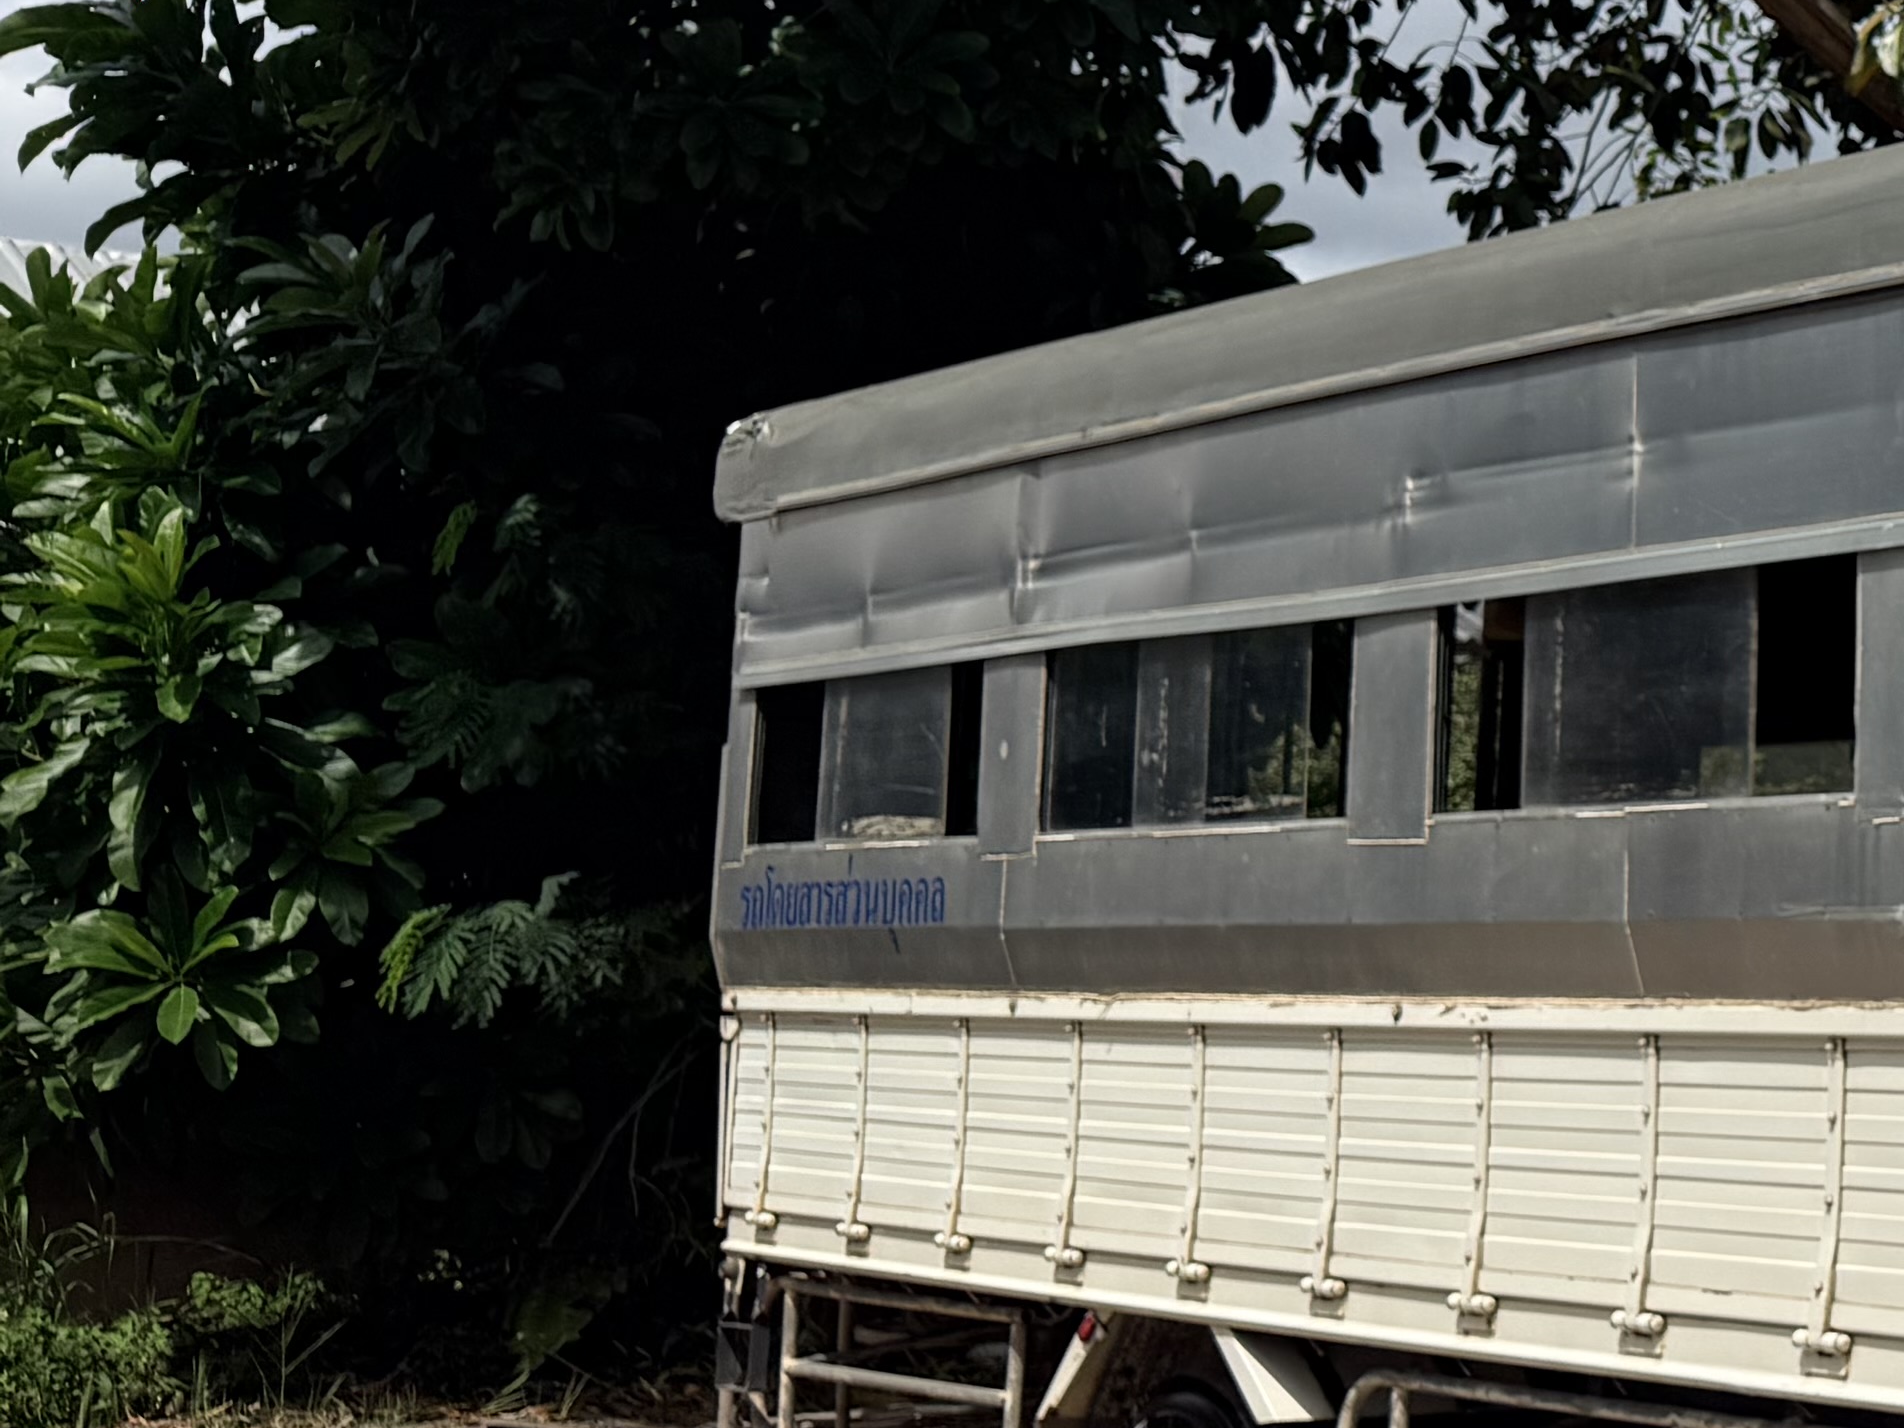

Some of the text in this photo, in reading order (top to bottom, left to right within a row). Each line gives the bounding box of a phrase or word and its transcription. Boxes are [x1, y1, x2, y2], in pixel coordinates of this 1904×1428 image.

[740, 853, 946, 954] รถโดยสารส่วนบุคคล
